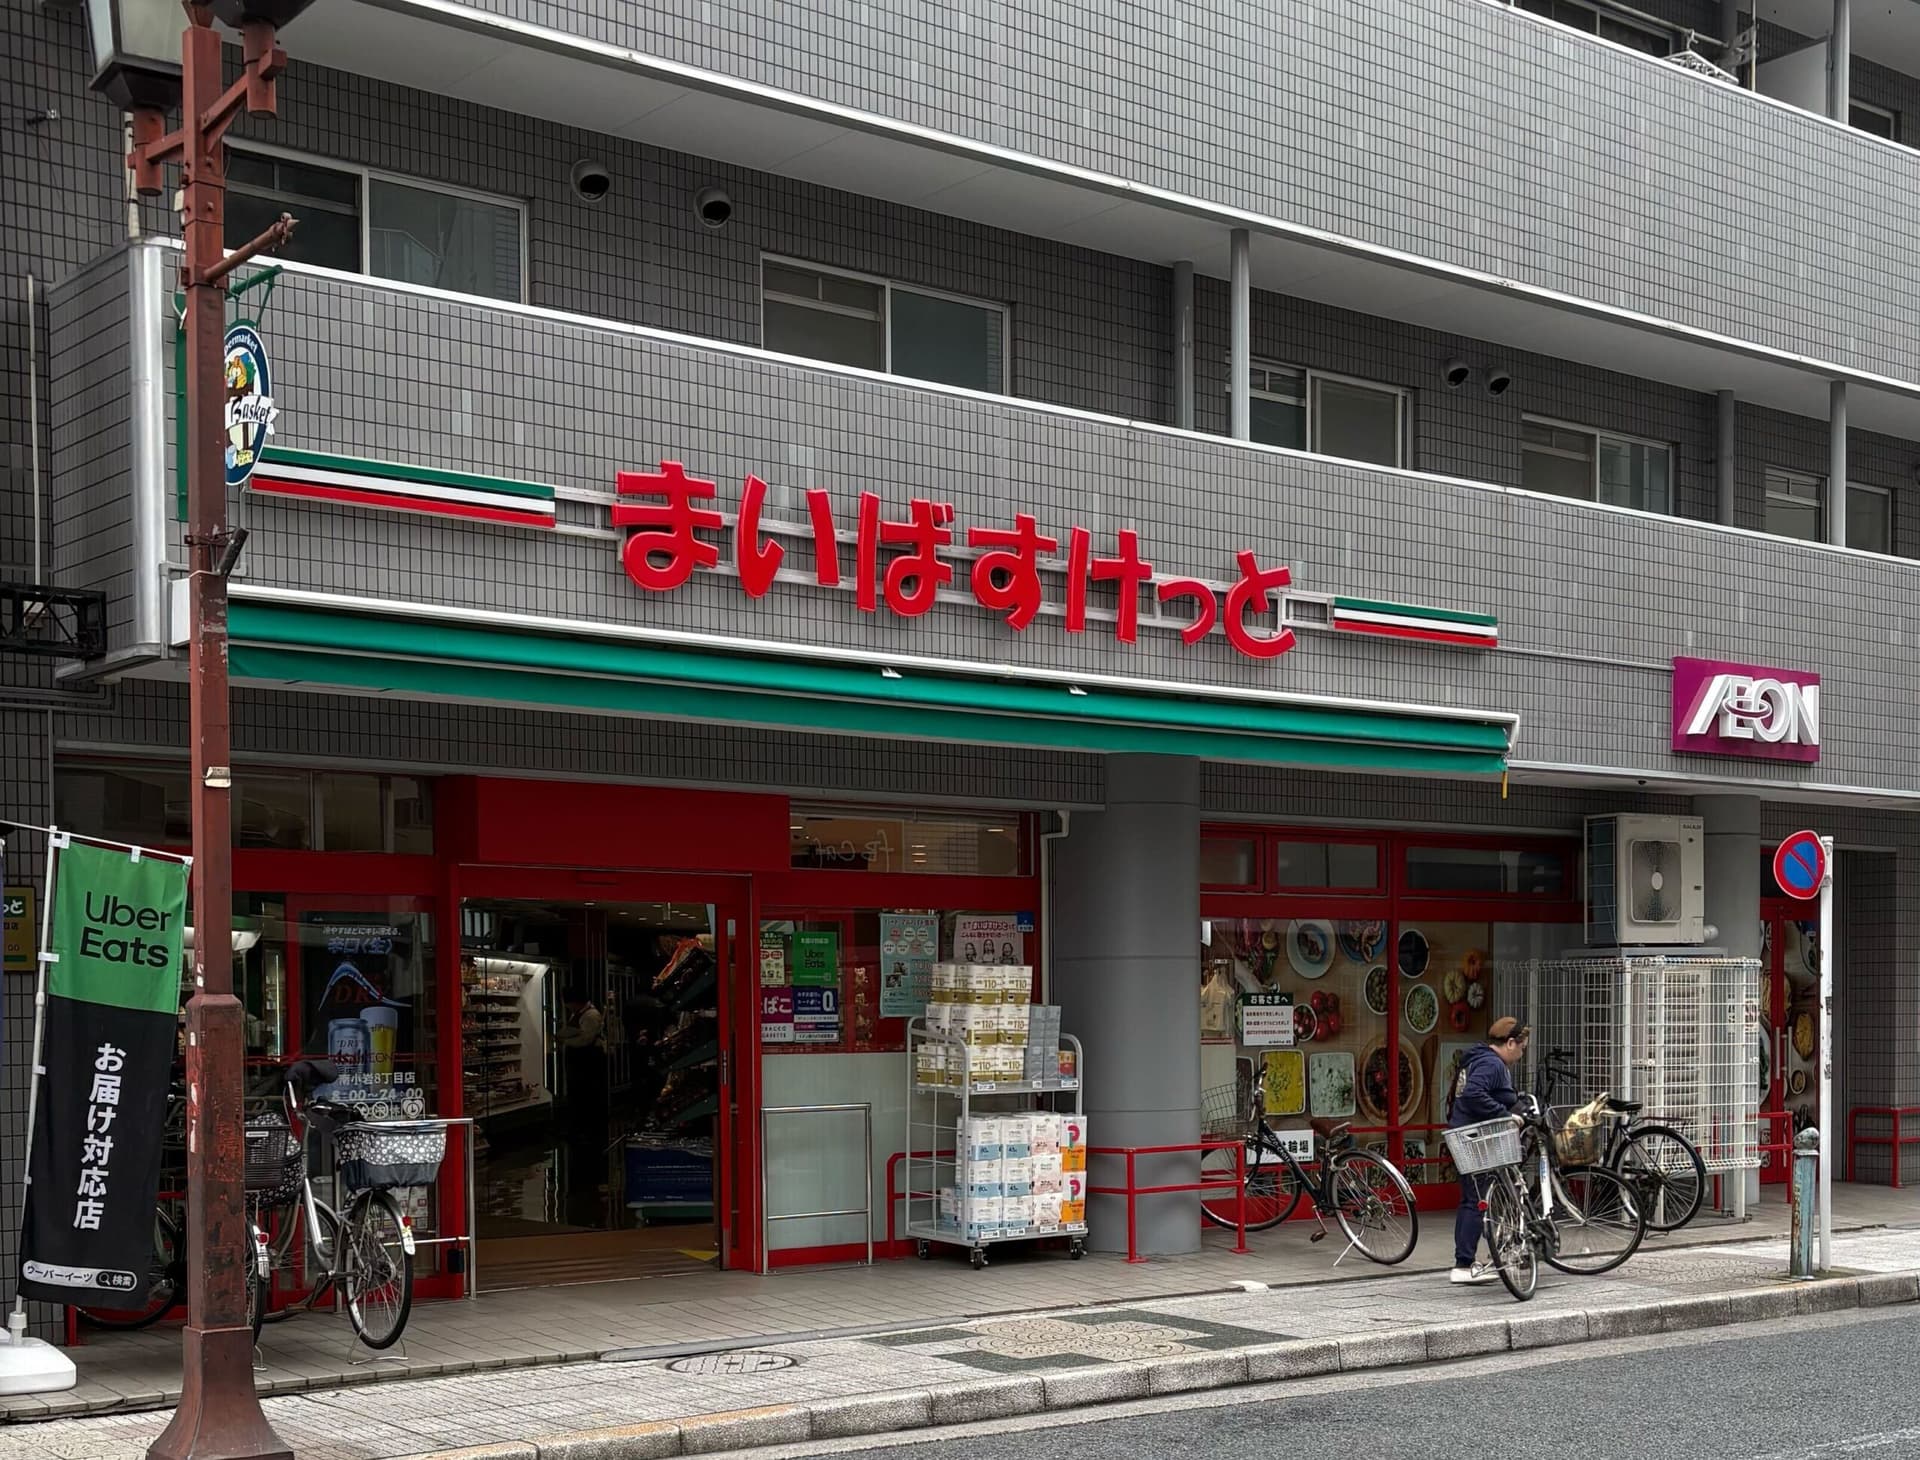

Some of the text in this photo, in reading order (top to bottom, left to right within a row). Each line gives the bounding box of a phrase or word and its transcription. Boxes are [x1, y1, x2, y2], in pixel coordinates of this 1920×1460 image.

[231, 395, 271, 424] Basket
[612, 460, 1296, 660] まいばすけっと
[85, 891, 172, 932] Uber
[80, 926, 169, 968] Eats
[761, 995, 793, 1014] ばこ
[338, 1071, 416, 1086] 南小岩8丁目店
[72, 1042, 127, 1231] お届け対応店
[27, 1265, 132, 1287] ウーバーイーツ 検索
